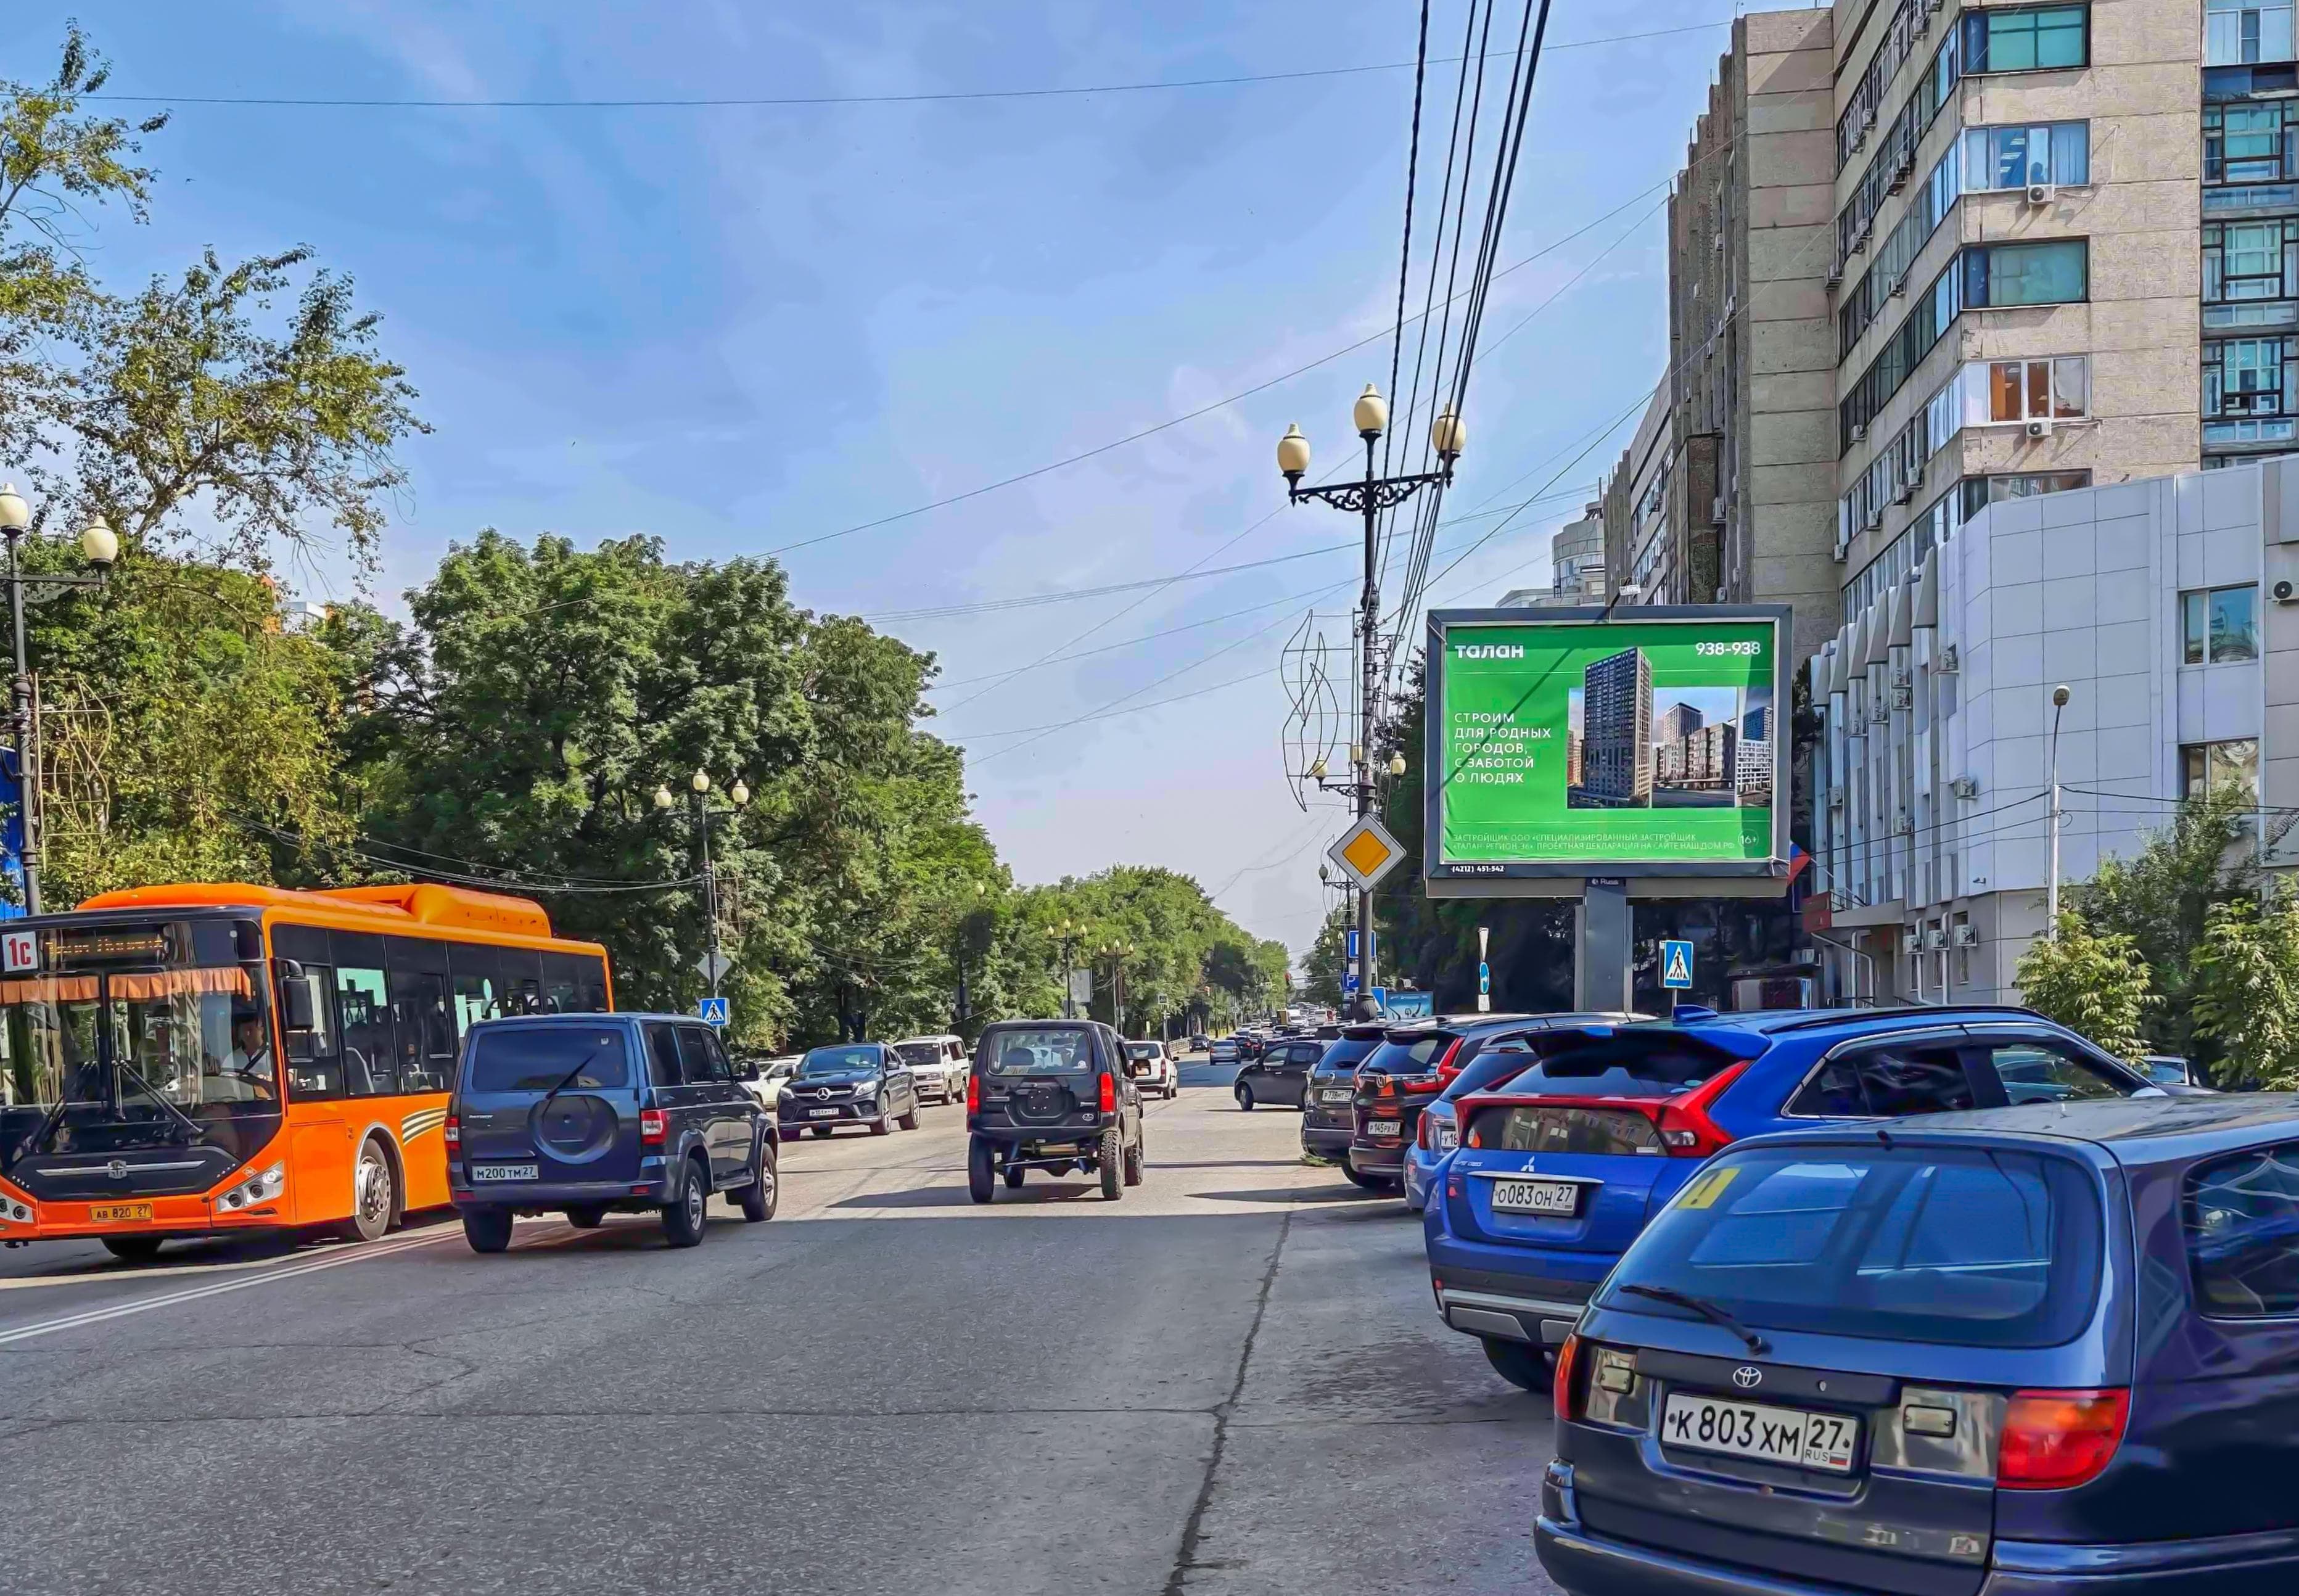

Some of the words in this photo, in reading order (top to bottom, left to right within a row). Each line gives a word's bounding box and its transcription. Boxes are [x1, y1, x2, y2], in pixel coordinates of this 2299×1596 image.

[1454, 644, 1524, 659] талан
[1695, 641, 1761, 656] 938-938
[1454, 712, 1515, 723] СТРОИМ
[1454, 728, 1484, 740] ДЛЯ
[1489, 728, 1551, 740] РОДНЫХ
[1455, 742, 1528, 755] ГОРОДОВ,
[1455, 758, 1463, 768] С
[1467, 756, 1534, 768] ЗАБОТОЙ
[1455, 773, 1465, 783] О
[1470, 773, 1524, 785] ЛЮДЯХ
[1740, 835, 1758, 844] 16+
[522, 1167, 533, 1175] 27
[1557, 1186, 1573, 1202] 27
[113, 1207, 131, 1218] 820
[138, 1206, 148, 1216] 27
[1676, 1405, 1800, 1456] К803ХМ
[1809, 1418, 1844, 1450] 27
[1804, 1449, 1829, 1462] RUS
